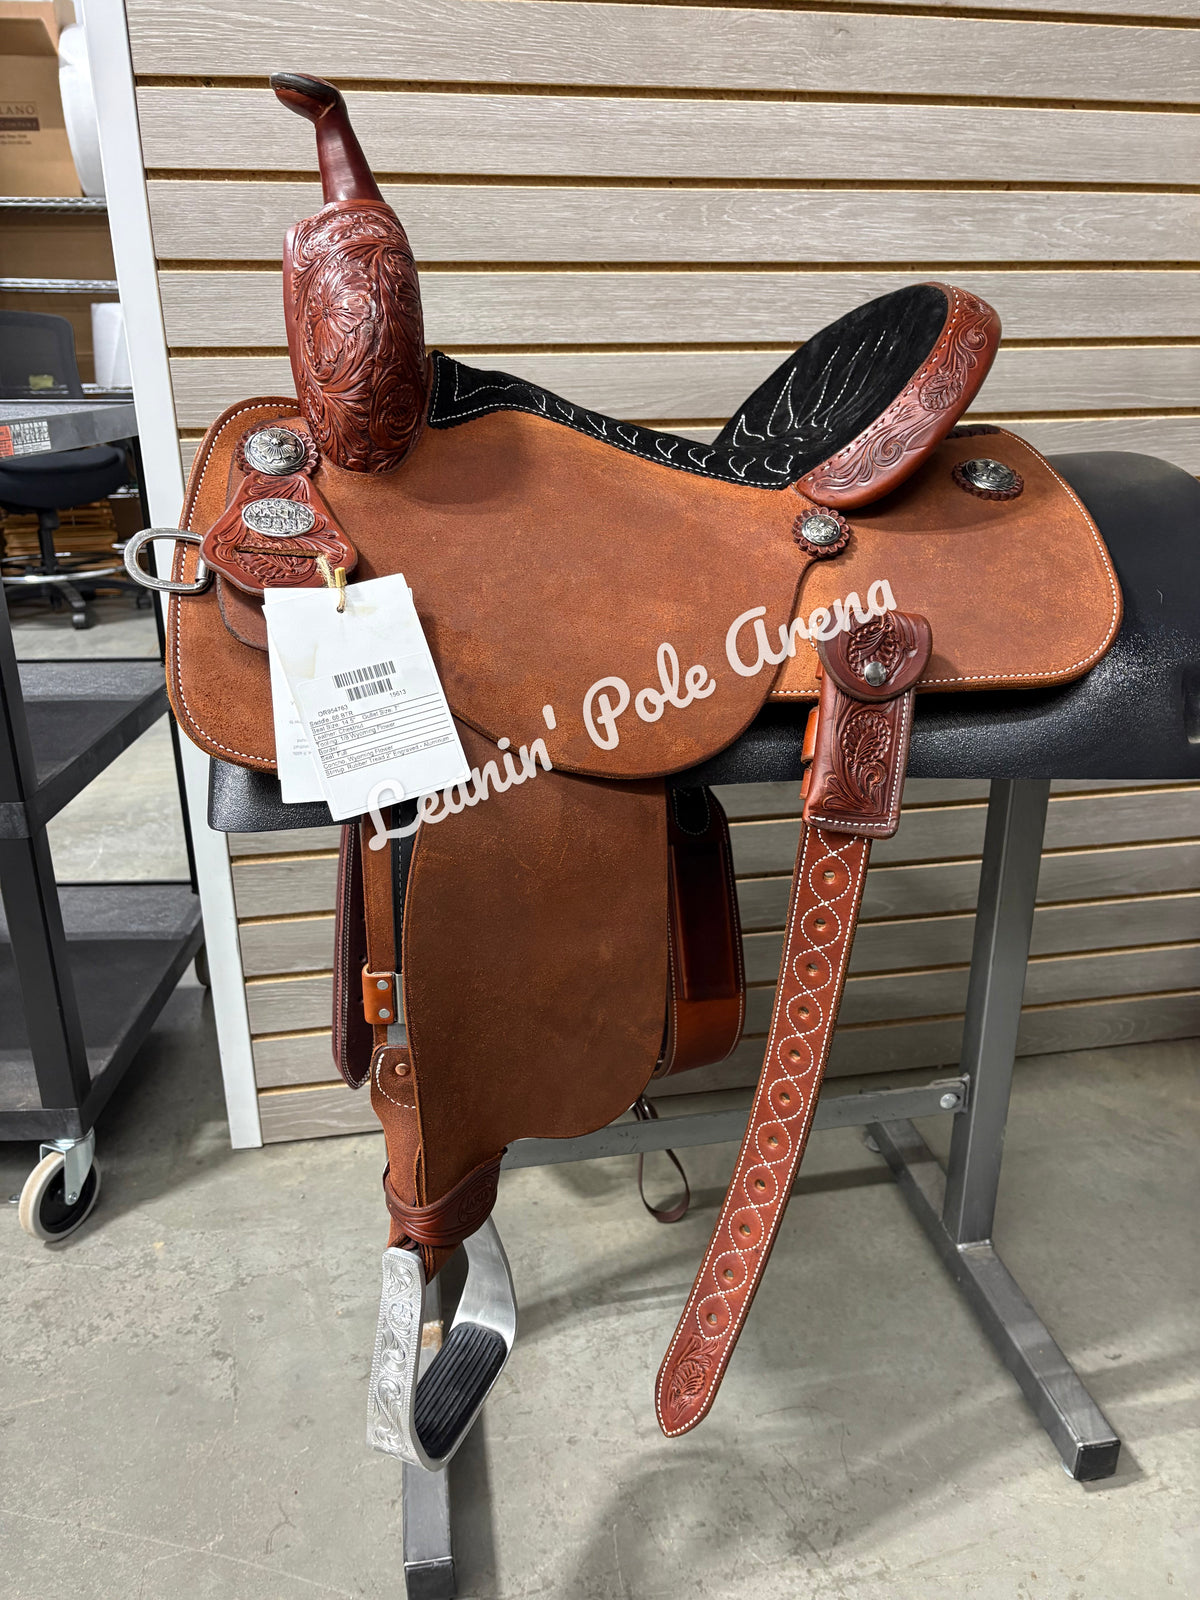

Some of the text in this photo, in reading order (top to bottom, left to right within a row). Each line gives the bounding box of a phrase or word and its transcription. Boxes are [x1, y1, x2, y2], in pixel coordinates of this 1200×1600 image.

[338, 722, 364, 735] Chestnut
[349, 726, 377, 741] Wyoming
[376, 720, 396, 731] Flower
[347, 750, 375, 764] Wyoming
[374, 744, 394, 754] Flower
[347, 760, 368, 770] Rubber
[369, 755, 386, 763] Tread
[393, 745, 420, 758] Engraved
